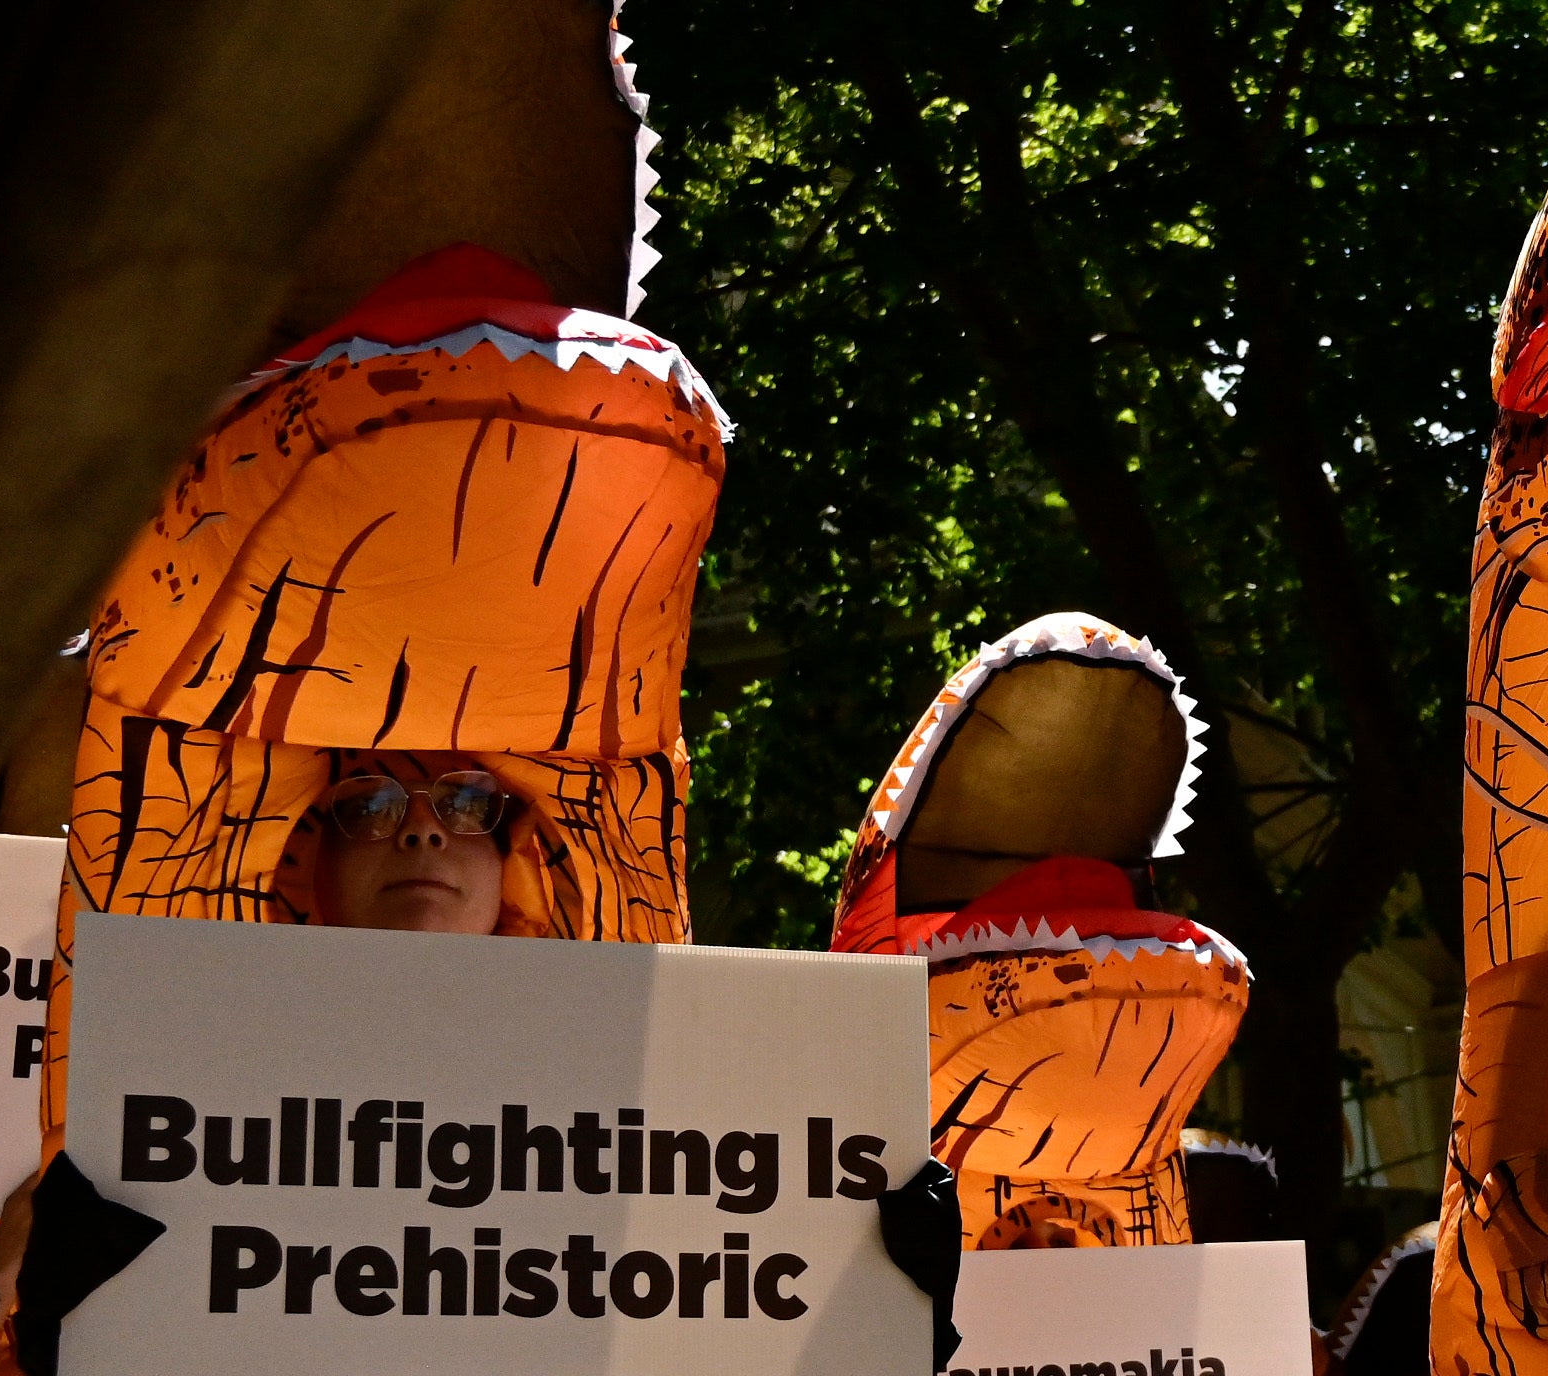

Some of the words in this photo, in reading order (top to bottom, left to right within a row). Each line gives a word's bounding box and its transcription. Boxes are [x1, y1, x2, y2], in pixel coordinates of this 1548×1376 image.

[120, 1093, 780, 1214] Bullfighting
[806, 1116, 889, 1201] Is
[208, 1224, 809, 1321] Prehistoric
